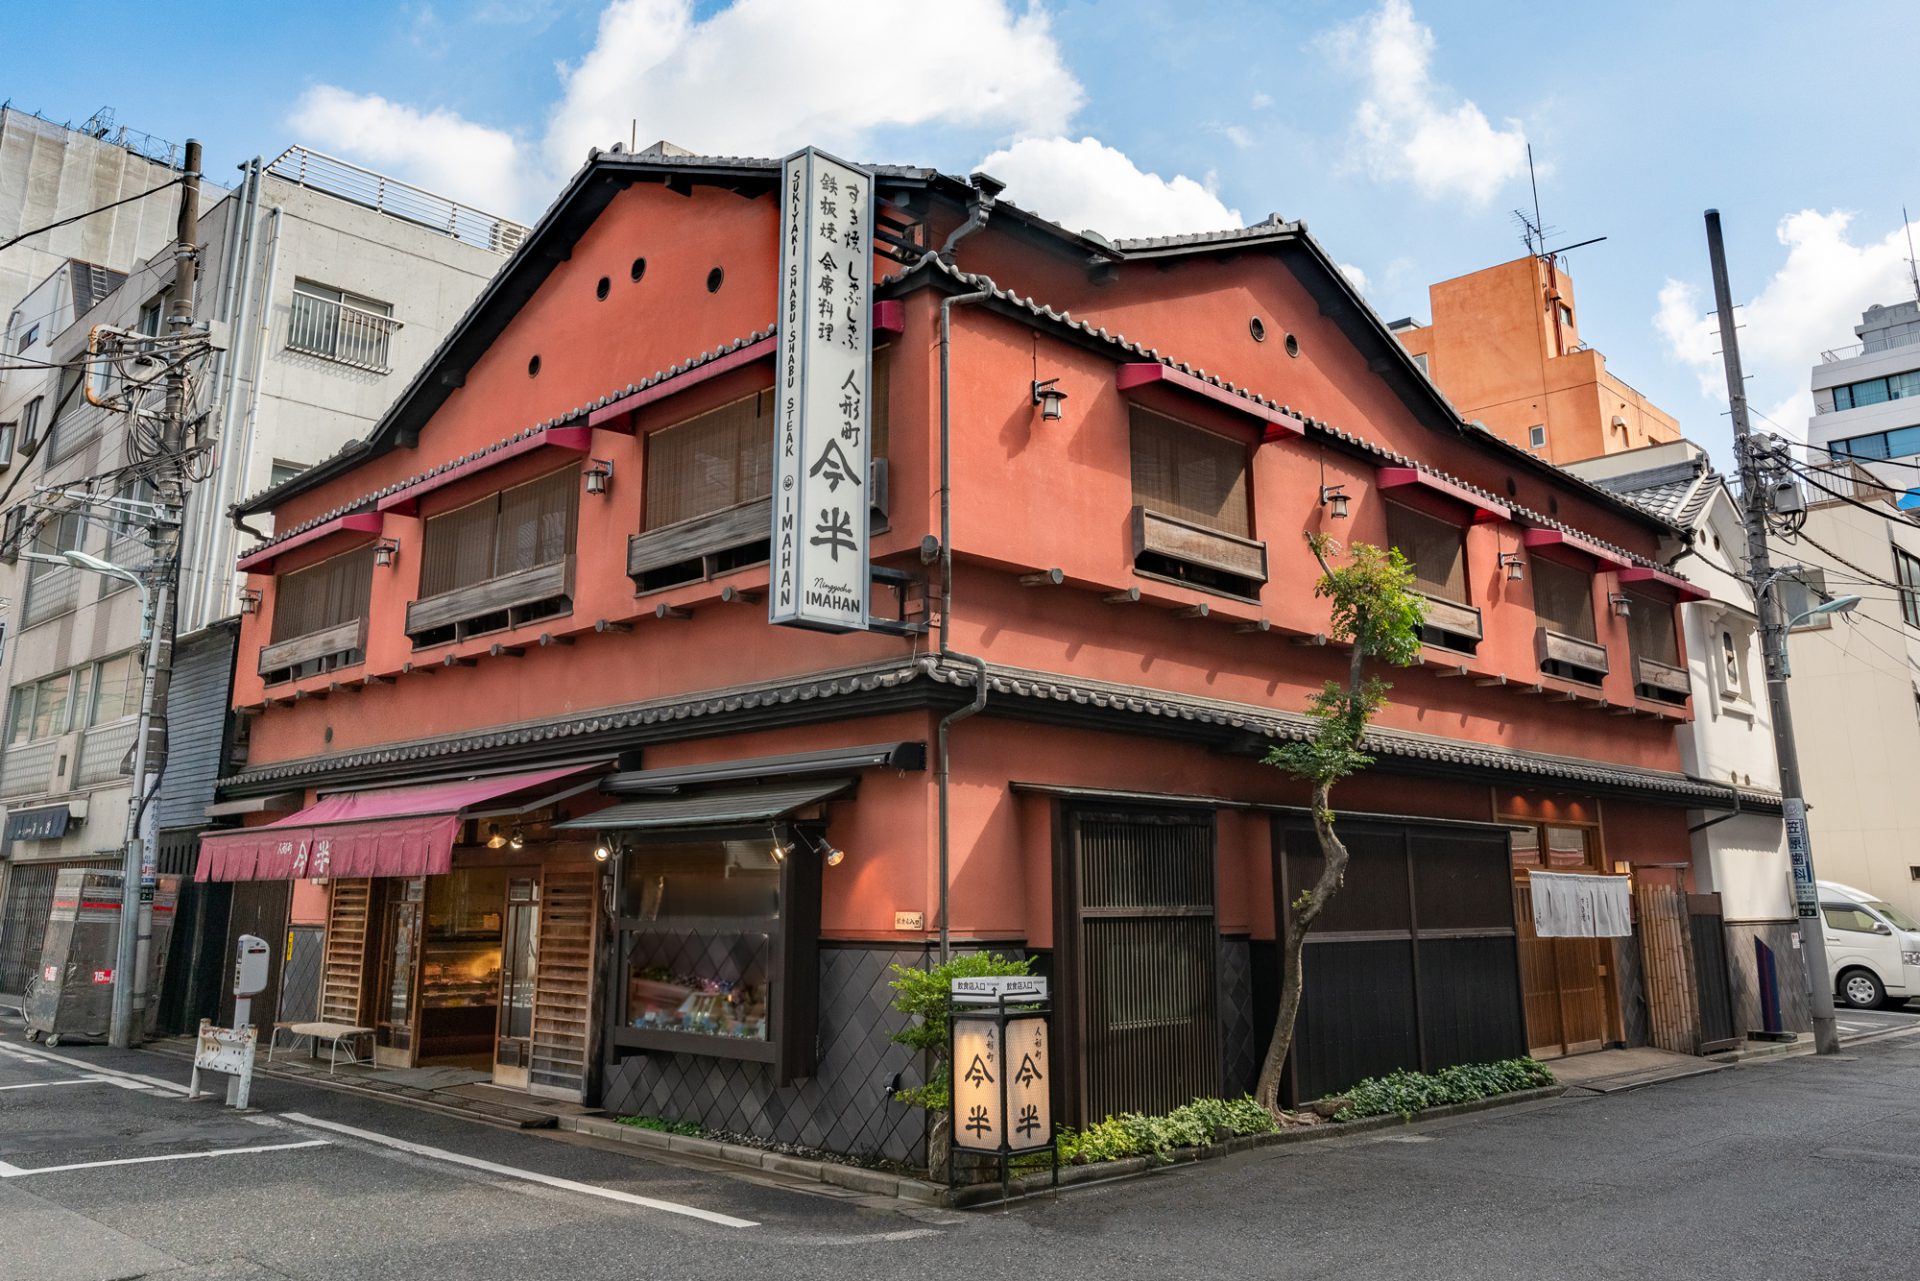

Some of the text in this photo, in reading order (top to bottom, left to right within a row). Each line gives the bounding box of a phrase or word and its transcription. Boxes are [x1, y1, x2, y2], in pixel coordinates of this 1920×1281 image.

[817, 172, 839, 342] 鉄板焼 会席料理
[780, 170, 801, 606] SUKIYAKI SHABU-SHABU STEAK IMAHAN
[839, 369, 861, 448] 人形町
[809, 438, 862, 563] 今半
[806, 590, 860, 613] IMAHAN
[293, 840, 330, 875] 今半
[1786, 820, 1807, 882] 笠原歯科
[958, 981, 986, 991] 飲食店入口
[1006, 981, 1033, 991] 飲食店入口
[986, 1028, 994, 1063] 人形町
[1034, 1026, 1042, 1060] 人形町
[964, 1053, 995, 1140] 今半
[1014, 1052, 1043, 1140] 今半
